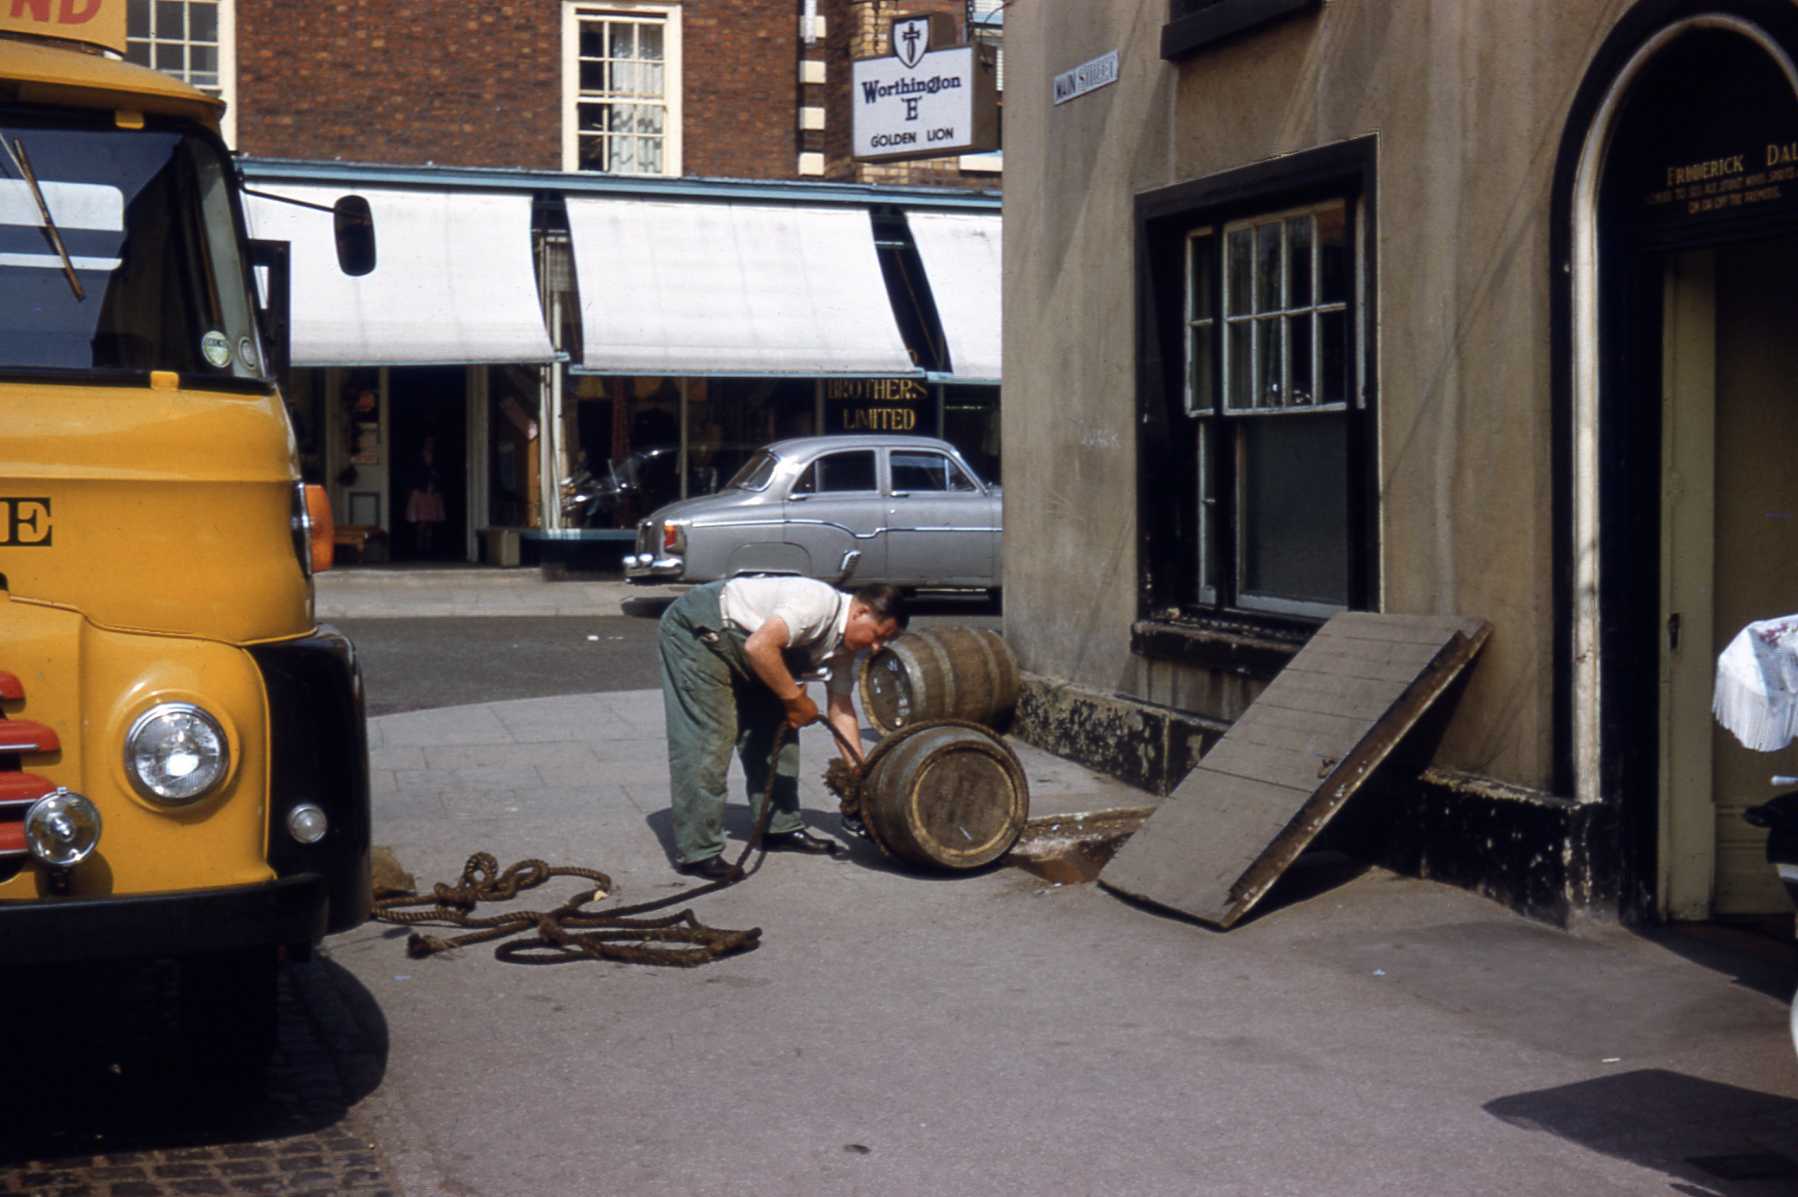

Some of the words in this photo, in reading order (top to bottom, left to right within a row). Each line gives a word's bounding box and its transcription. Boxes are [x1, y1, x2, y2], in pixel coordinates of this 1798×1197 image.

[861, 75, 962, 104] Worthington
[871, 132, 917, 148] GOLDEN
[927, 128, 954, 142] LION
[827, 379, 928, 400] BROTHERS
